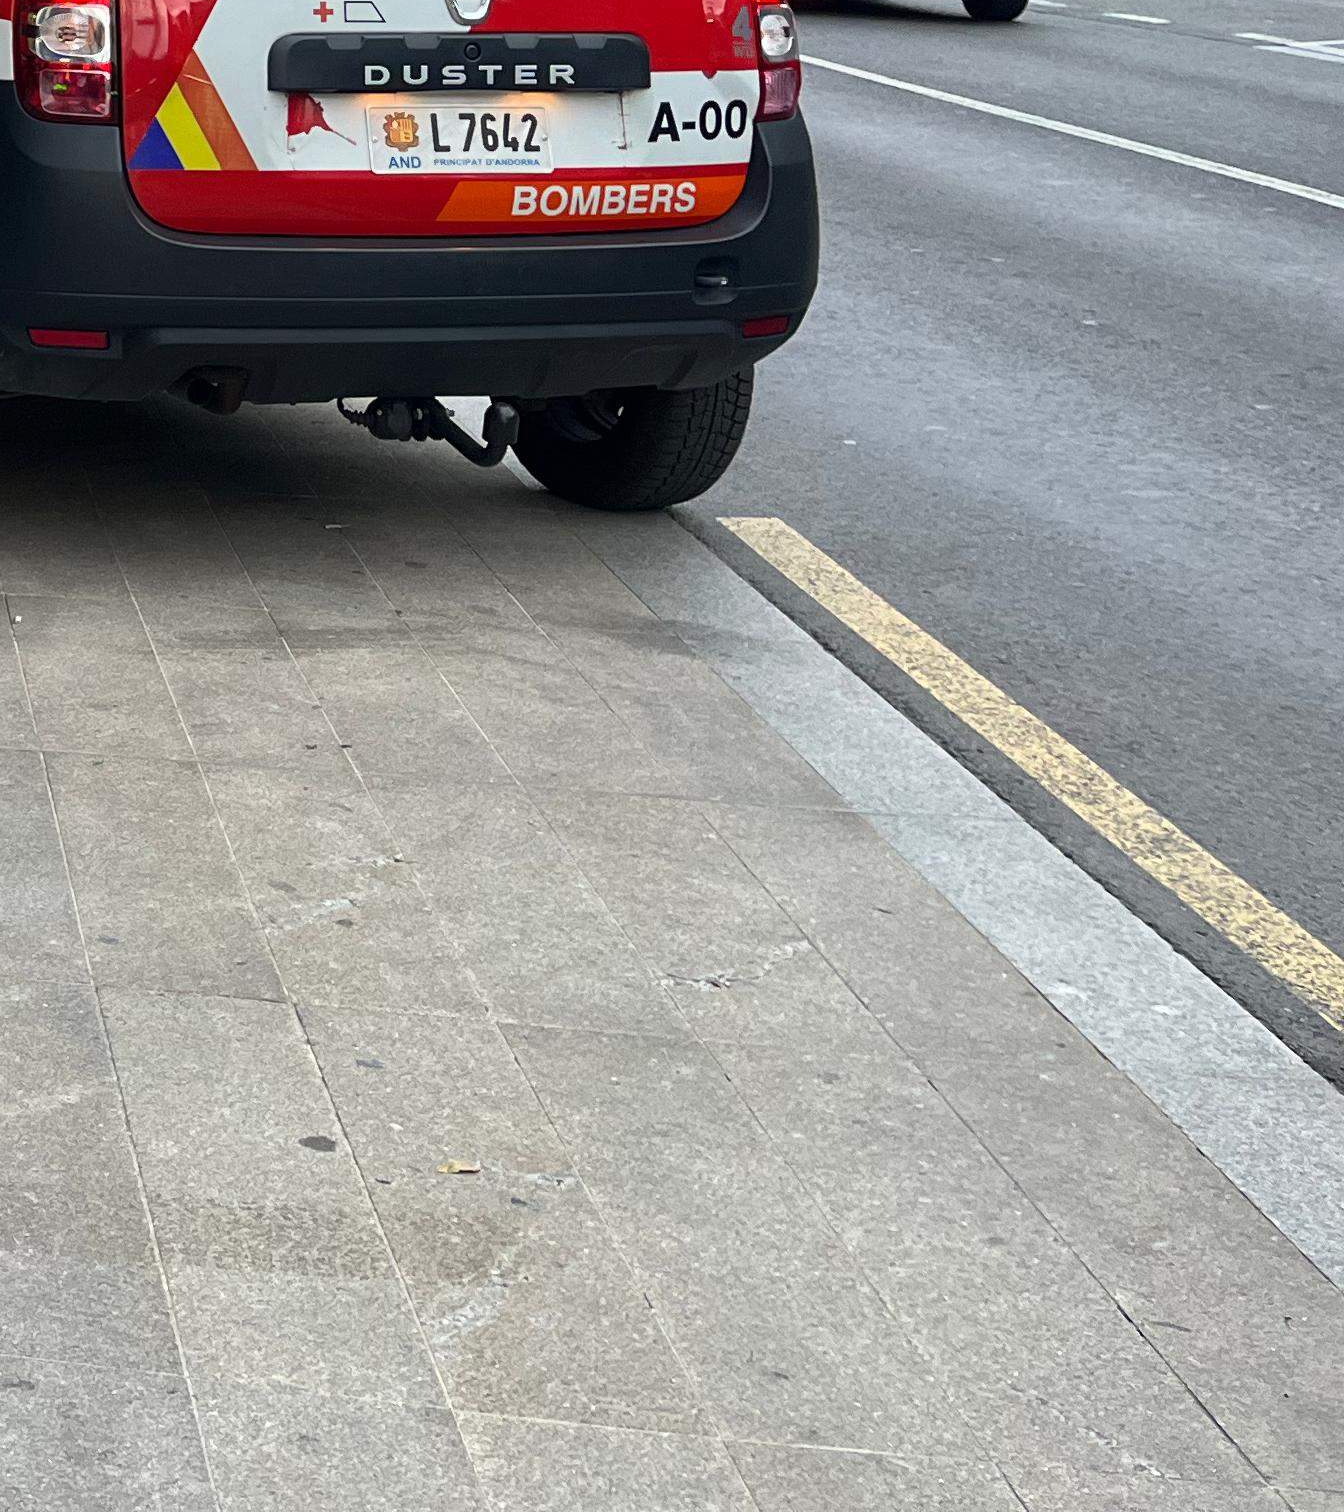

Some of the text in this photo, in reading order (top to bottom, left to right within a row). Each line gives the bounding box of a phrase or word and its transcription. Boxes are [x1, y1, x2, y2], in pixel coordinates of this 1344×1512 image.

[364, 64, 575, 86] DUSTER
[430, 112, 541, 153] L 7642
[647, 99, 748, 143] A-00
[388, 155, 422, 169] AND
[433, 157, 541, 167] PRINCIPAT D'ANDORRA
[511, 181, 696, 217] BOMBERS
